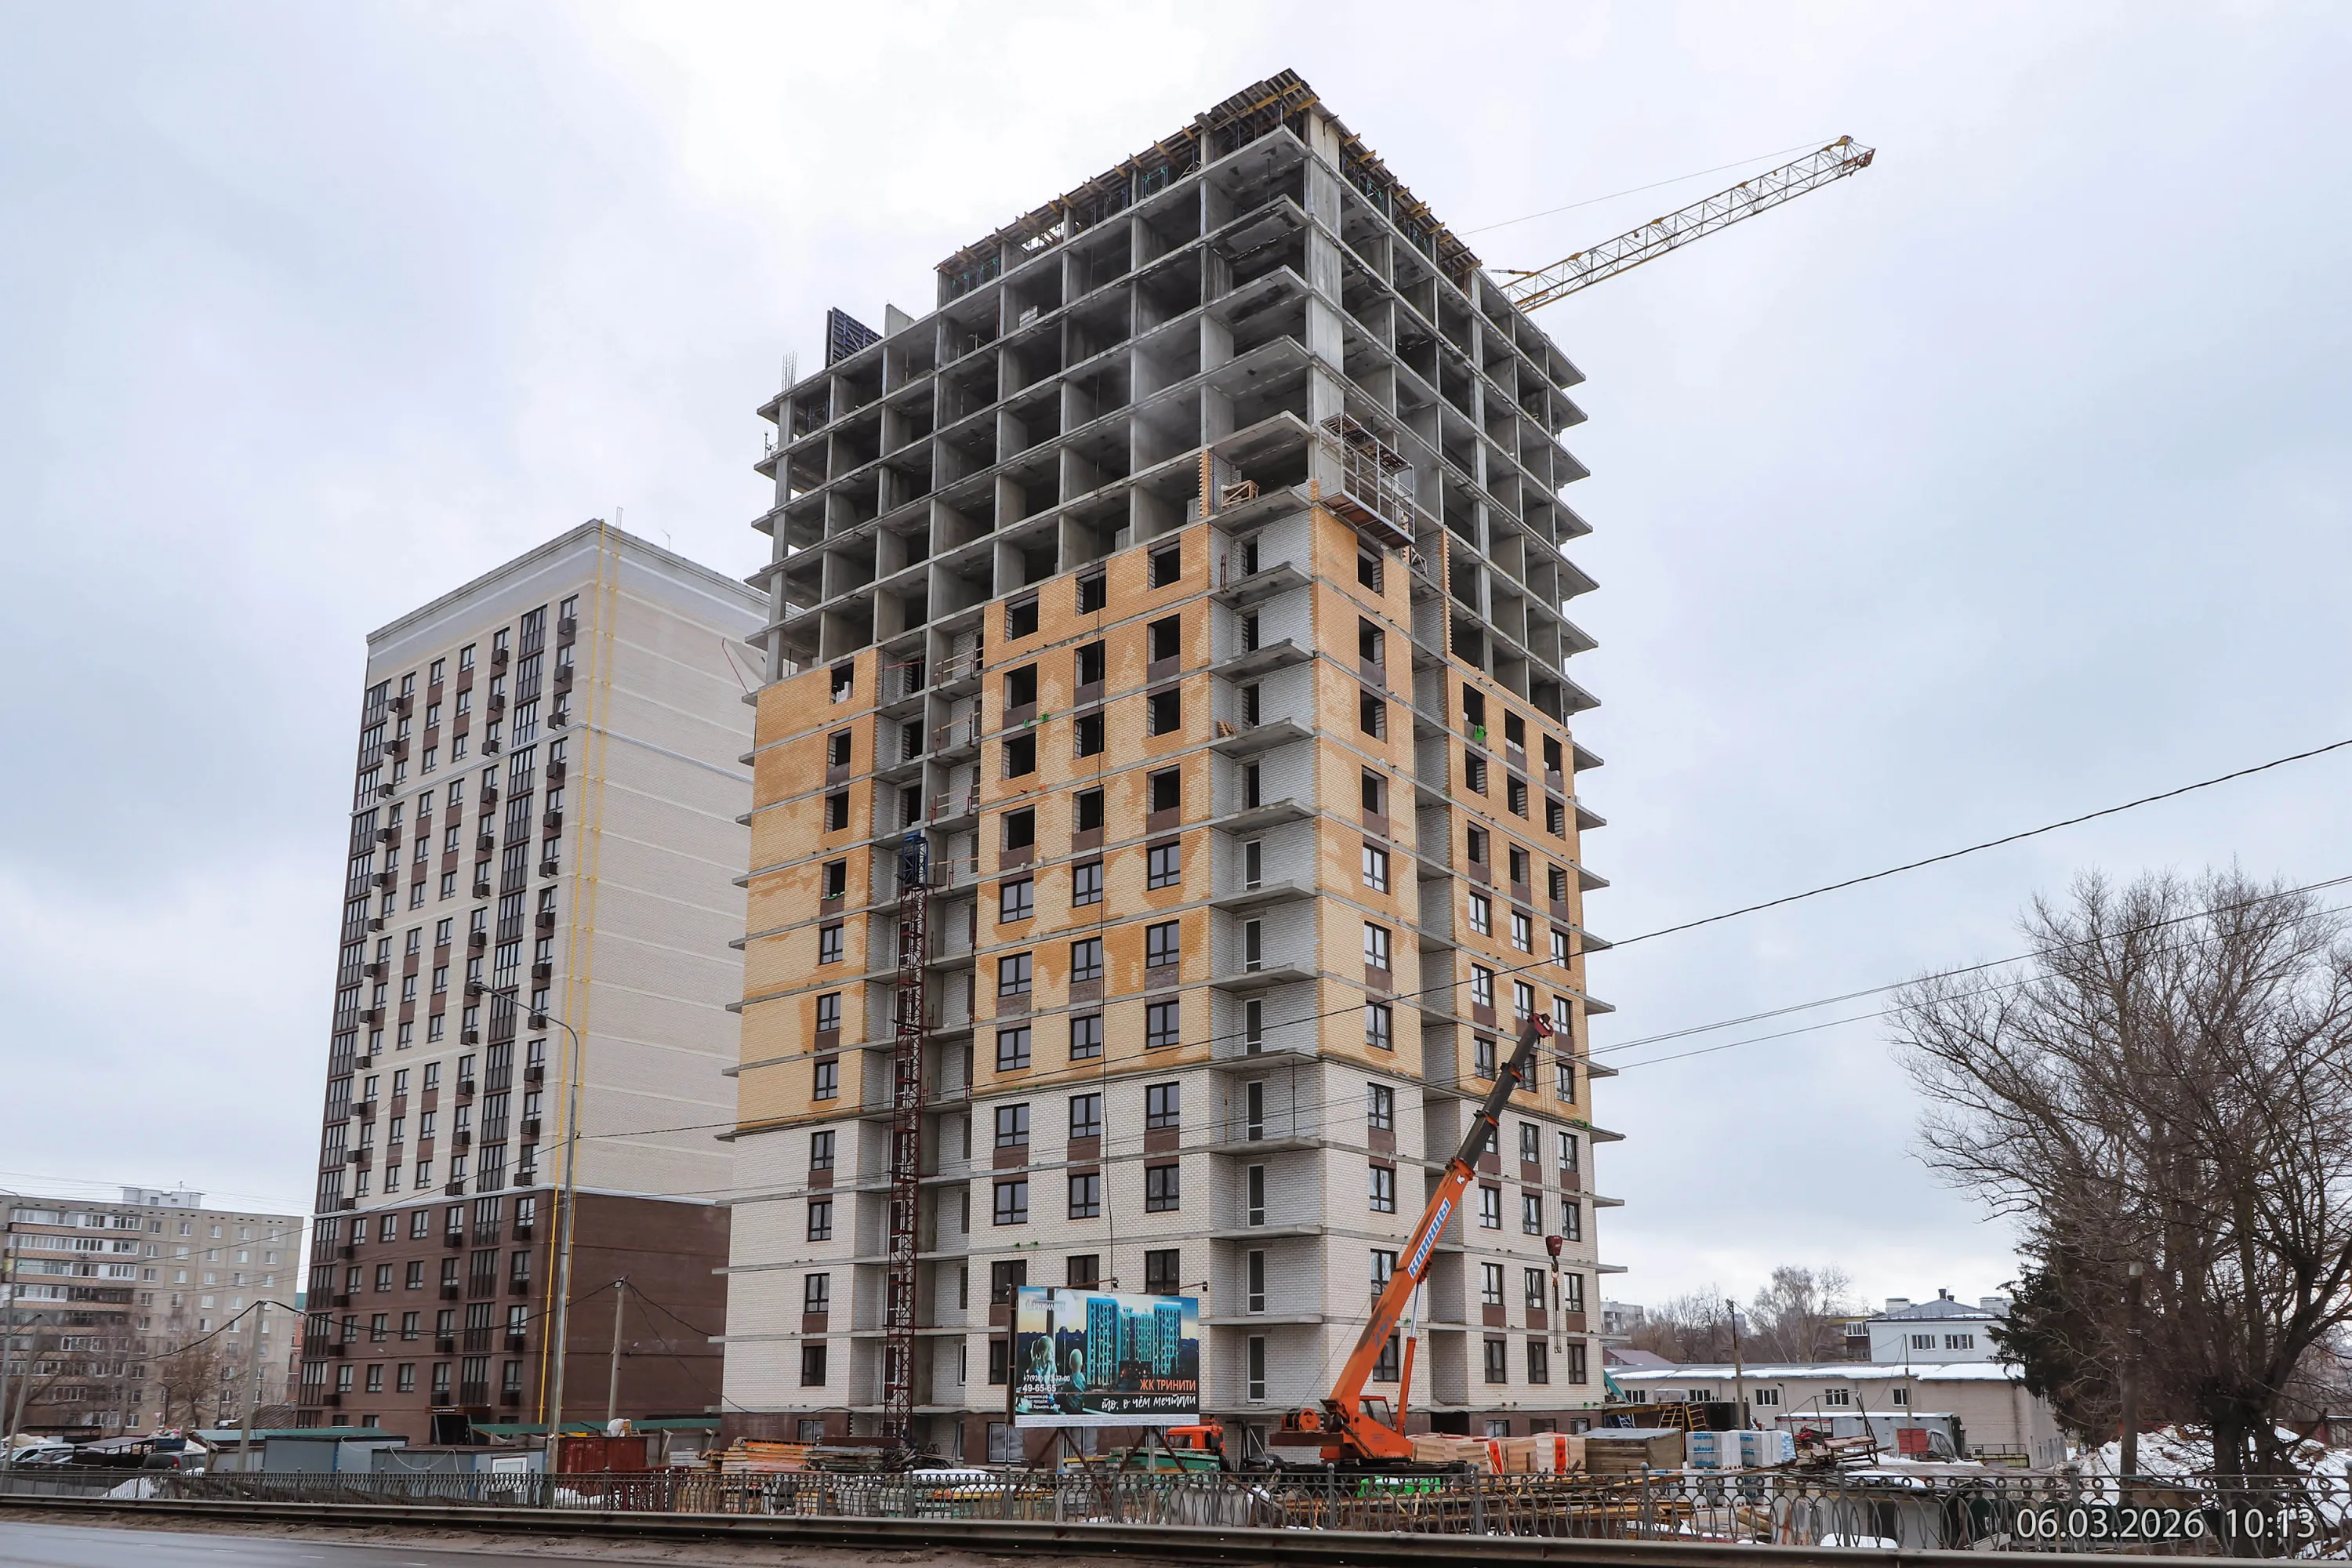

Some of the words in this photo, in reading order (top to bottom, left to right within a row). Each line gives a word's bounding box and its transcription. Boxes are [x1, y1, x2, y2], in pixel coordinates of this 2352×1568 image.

[1409, 1200, 1450, 1277] КЛИНЦЫ
[1022, 1384, 1057, 1392] 49-65-65
[1140, 1379, 1155, 1391] ЖК
[1156, 1380, 1196, 1392] ТРИНИТИ
[1102, 1398, 1119, 1412] то,
[1123, 1399, 1131, 1409] о
[1132, 1396, 1151, 1408] чём
[1153, 1394, 1196, 1408] мечтали
